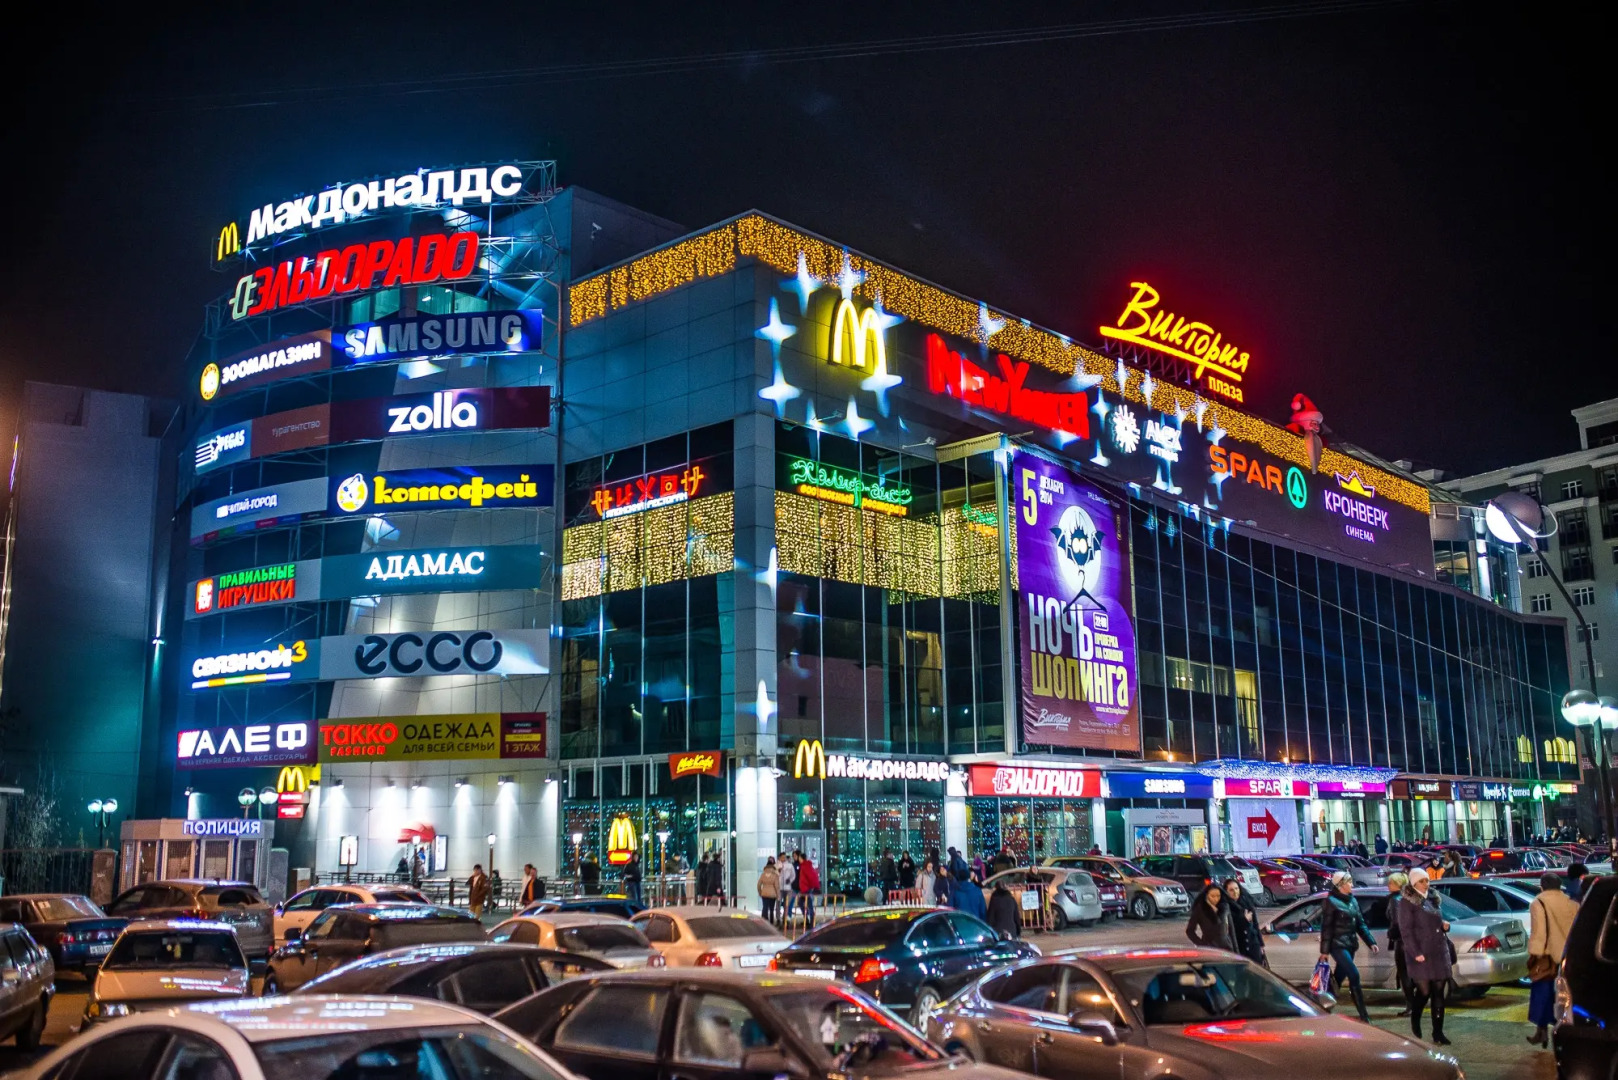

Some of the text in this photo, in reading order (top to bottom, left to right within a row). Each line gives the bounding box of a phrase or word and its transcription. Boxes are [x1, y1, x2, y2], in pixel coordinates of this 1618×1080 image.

[246, 166, 522, 245] Макдоналдс
[344, 314, 523, 358] SAMSUNG
[1115, 281, 1250, 376] Виктория
[221, 341, 321, 385] ЗООМАГАЗИН
[1208, 375, 1244, 403] плаза
[388, 392, 478, 433] zolla
[271, 420, 321, 438] турагентство
[1209, 444, 1284, 495] SPAR
[227, 494, 278, 514] ЧИТАЙ-ГОРОД
[373, 474, 538, 506] котофей
[1022, 467, 1038, 526] 5
[1324, 489, 1389, 531] КРОНВЕРК
[1345, 524, 1375, 543] СИНЕМА
[219, 564, 295, 589] ПРАВИЛЬНЫЕ
[365, 551, 485, 581] АДАМАС
[217, 579, 296, 609] ИГРУШКИ
[1028, 592, 1094, 660] НОЧЬ
[192, 645, 292, 678] СВЯЗНОЙ
[354, 631, 503, 675] ecco
[195, 723, 308, 757] АЛЕФ
[403, 722, 495, 741] ОДЕЖДА
[223, 756, 251, 764] ОДЕЖДА
[253, 753, 308, 762] АКСЕССУАРЫ
[330, 745, 386, 757] FASHION
[402, 742, 495, 754] ДЛЯ ВСЕЙ СЕМЬИ
[512, 743, 540, 752] ЭТАЖ
[827, 754, 950, 782] Макдоналдс
[1144, 778, 1186, 793] SAMSUNG
[1249, 780, 1281, 794] SPAR
[183, 820, 261, 836] ПОЛИЦИЯ
[1252, 822, 1268, 835] ВХОД
